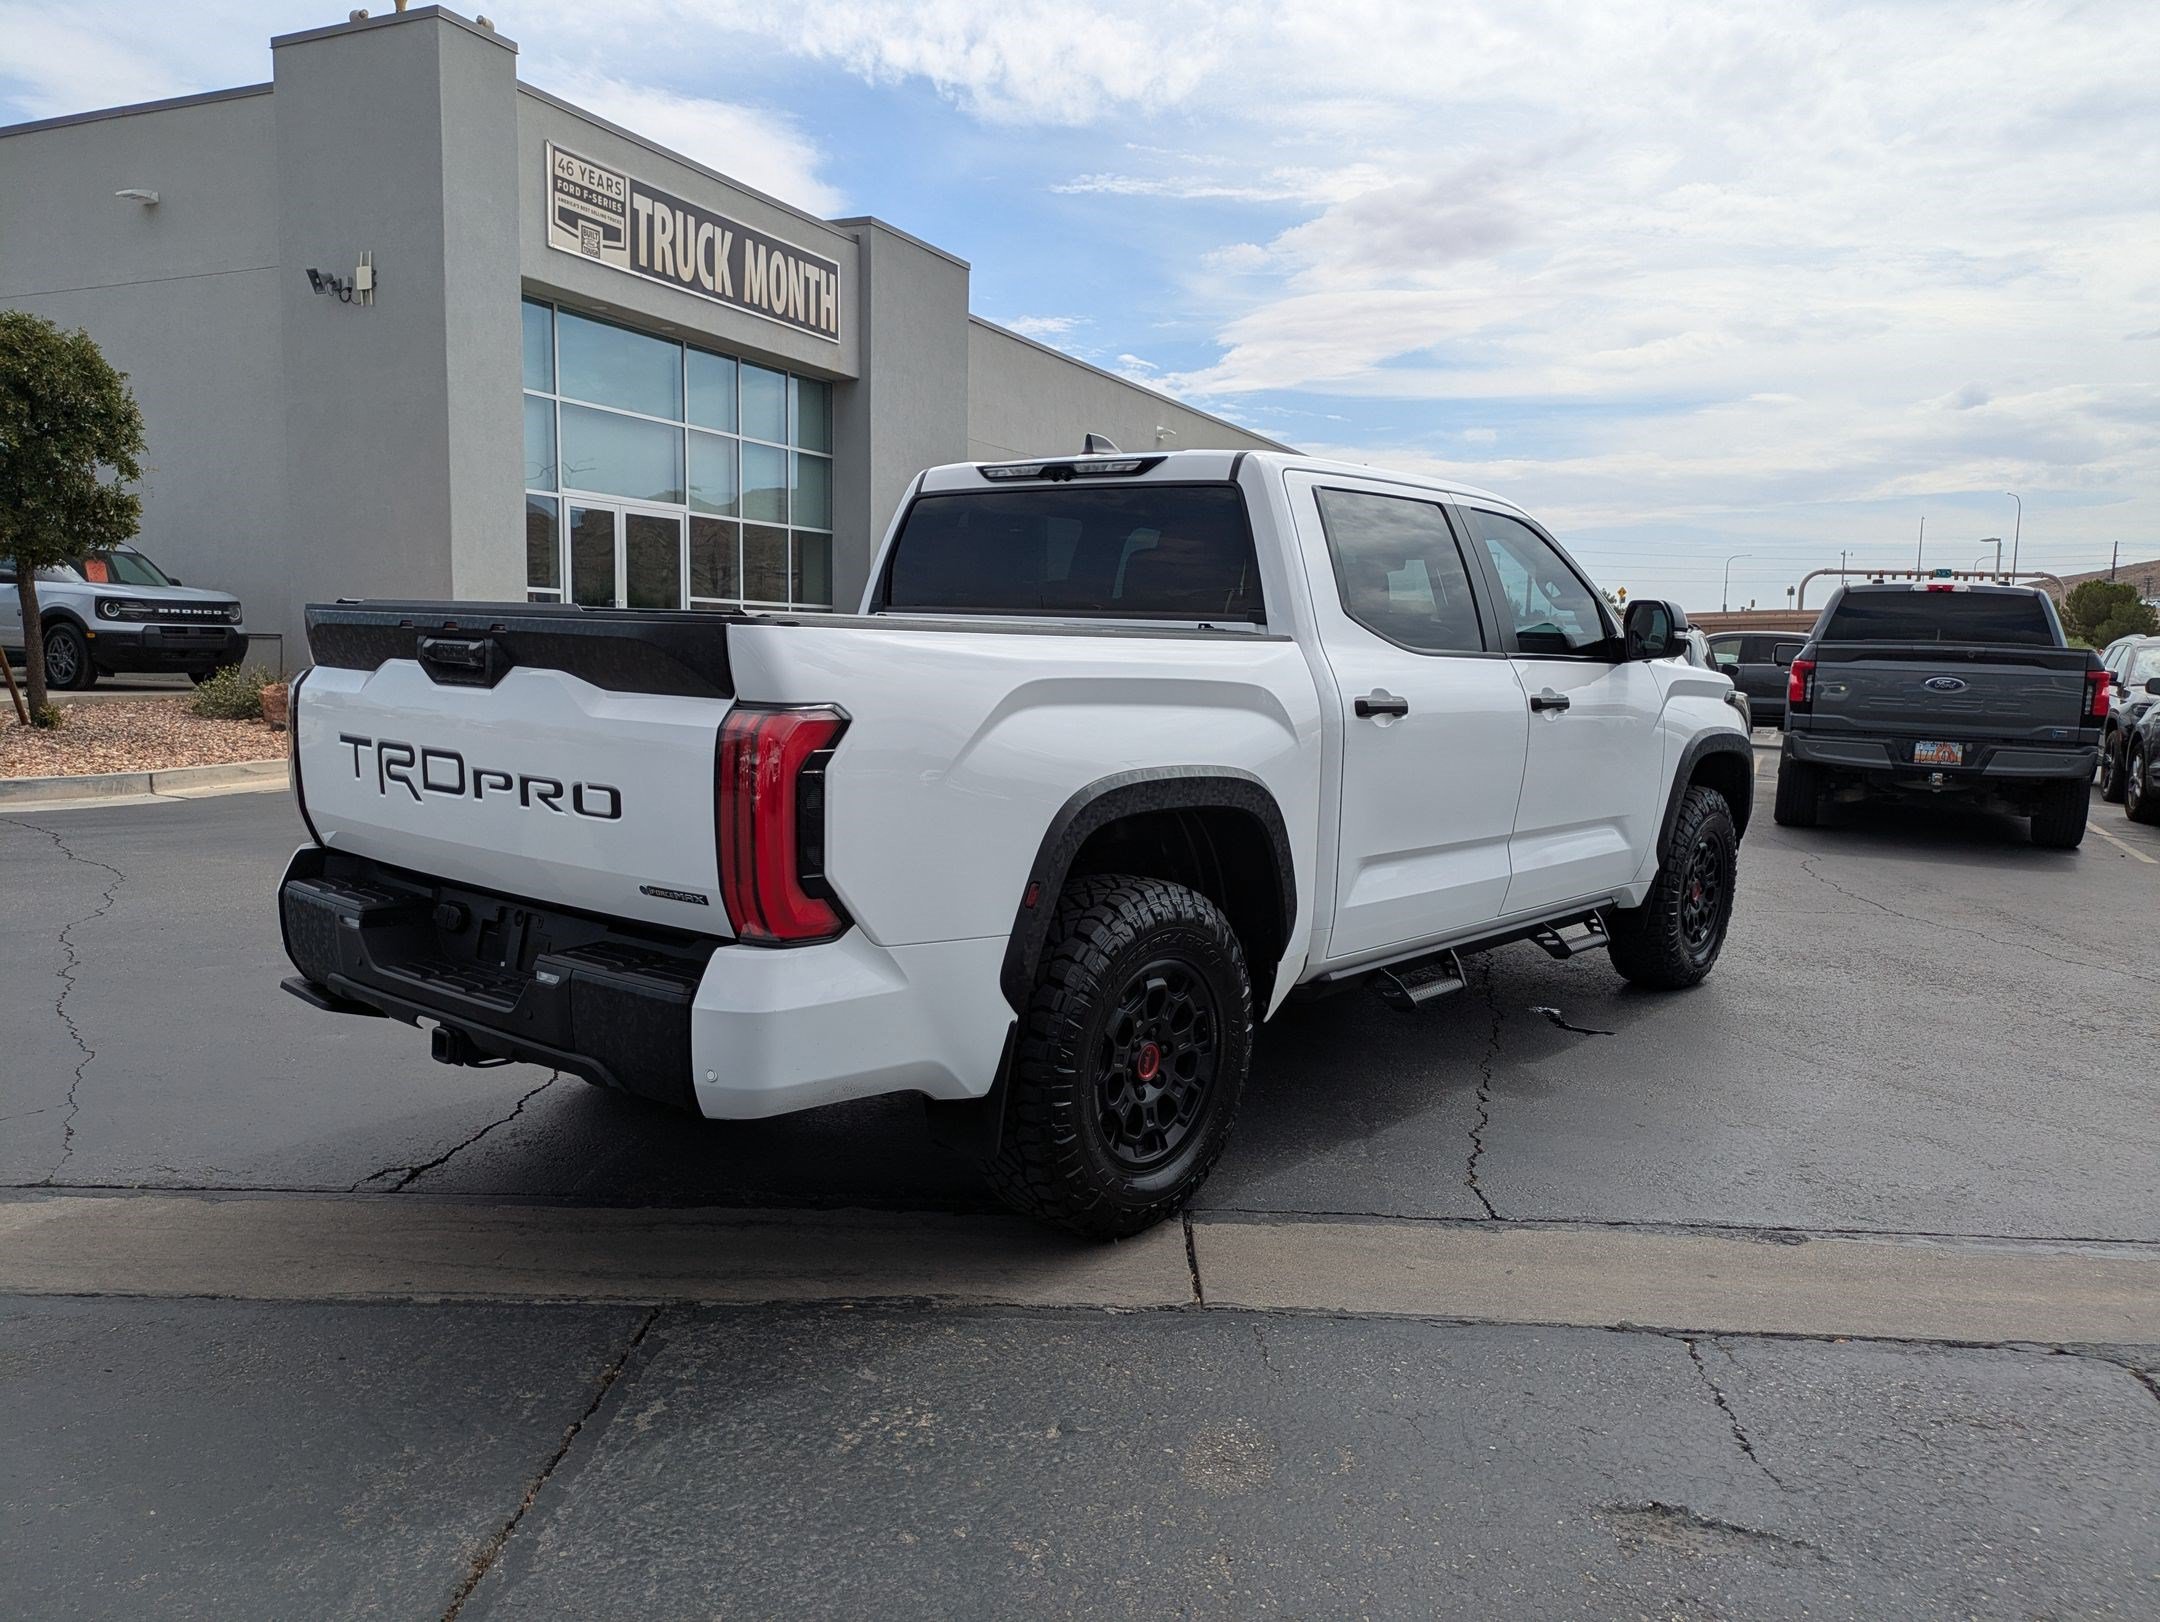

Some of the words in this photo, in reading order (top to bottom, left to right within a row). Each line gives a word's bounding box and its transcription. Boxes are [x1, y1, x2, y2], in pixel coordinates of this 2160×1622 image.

[557, 180, 581, 197] FORD
[583, 190, 623, 213] F-SERIES
[558, 158, 574, 177] 46
[579, 165, 622, 197] YEARS
[583, 227, 599, 241] BUILT
[633, 192, 734, 298] TRUCK
[744, 238, 836, 334] MONTH
[338, 731, 466, 804] TRD
[471, 767, 623, 822] PRO
